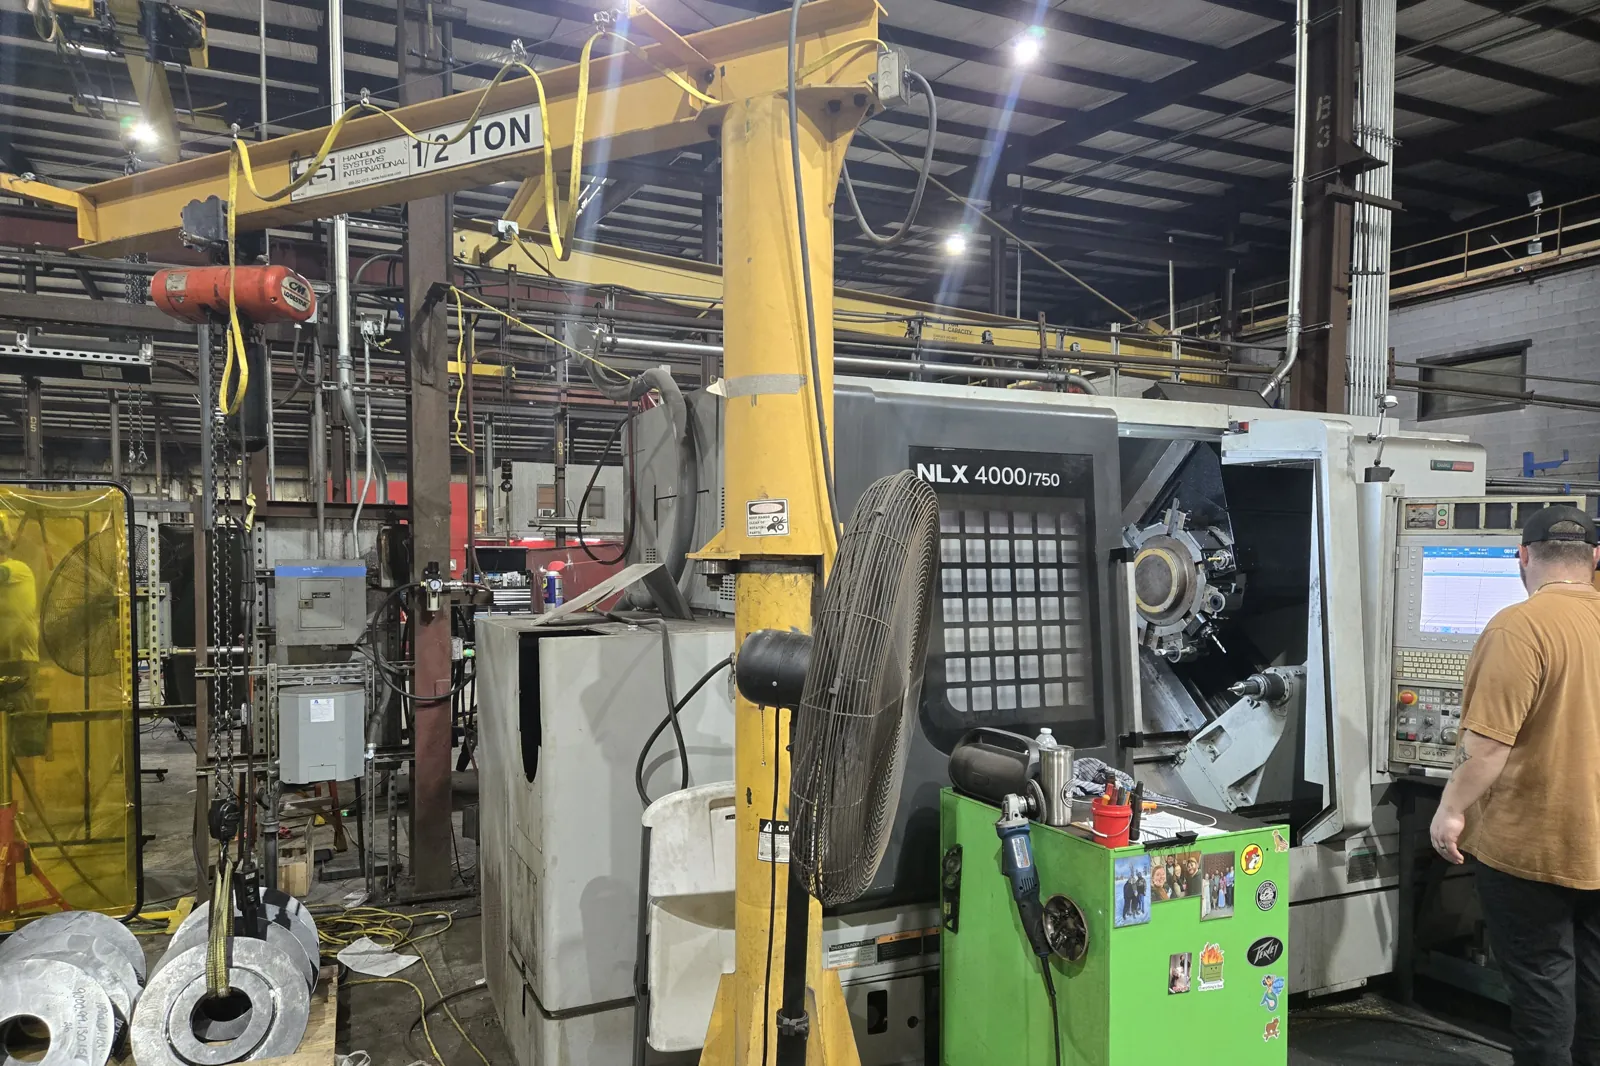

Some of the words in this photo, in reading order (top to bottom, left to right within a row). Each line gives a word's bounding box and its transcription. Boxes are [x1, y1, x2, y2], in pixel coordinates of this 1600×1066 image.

[412, 133, 449, 168] 1/2
[468, 113, 531, 156] TON
[342, 146, 386, 163] HANDLING
[342, 155, 384, 171] SYSTEMS
[343, 158, 408, 178] INTERNATIONAL
[289, 281, 306, 295] CM
[916, 462, 969, 484] NLX
[974, 465, 1060, 487] 4000/750
